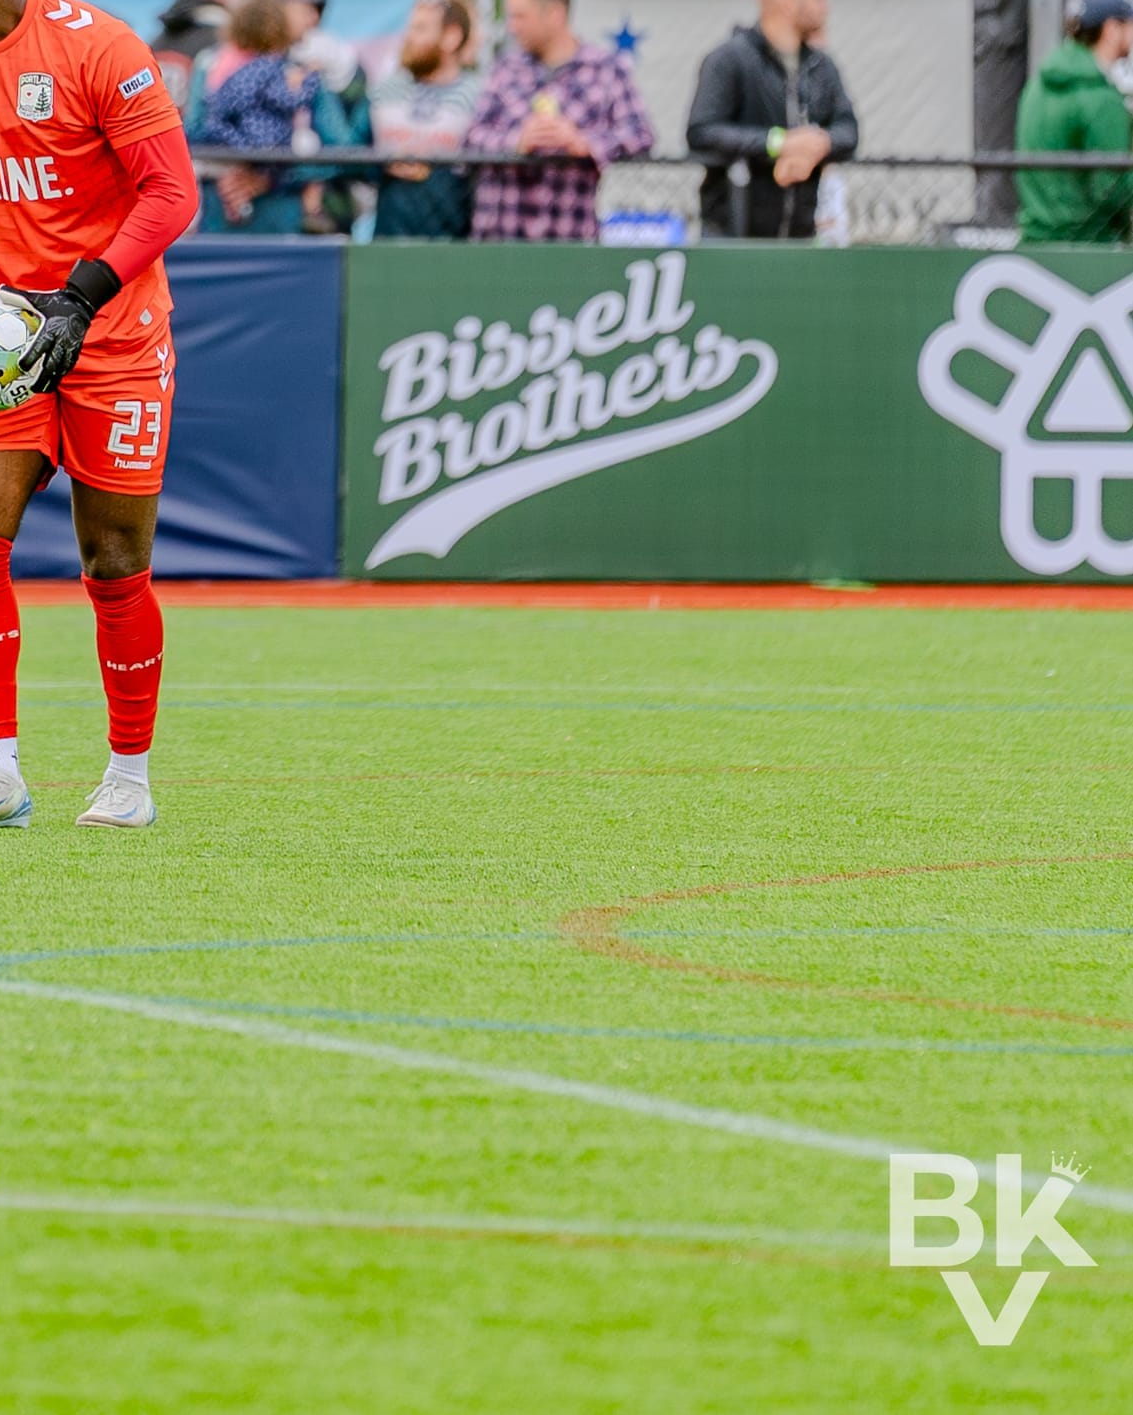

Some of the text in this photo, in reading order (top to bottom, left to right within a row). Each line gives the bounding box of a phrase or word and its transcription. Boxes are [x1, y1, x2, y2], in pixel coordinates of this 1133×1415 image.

[373, 324, 744, 505] Brothers
[378, 250, 696, 422] Bissell
[108, 400, 161, 456] 23
